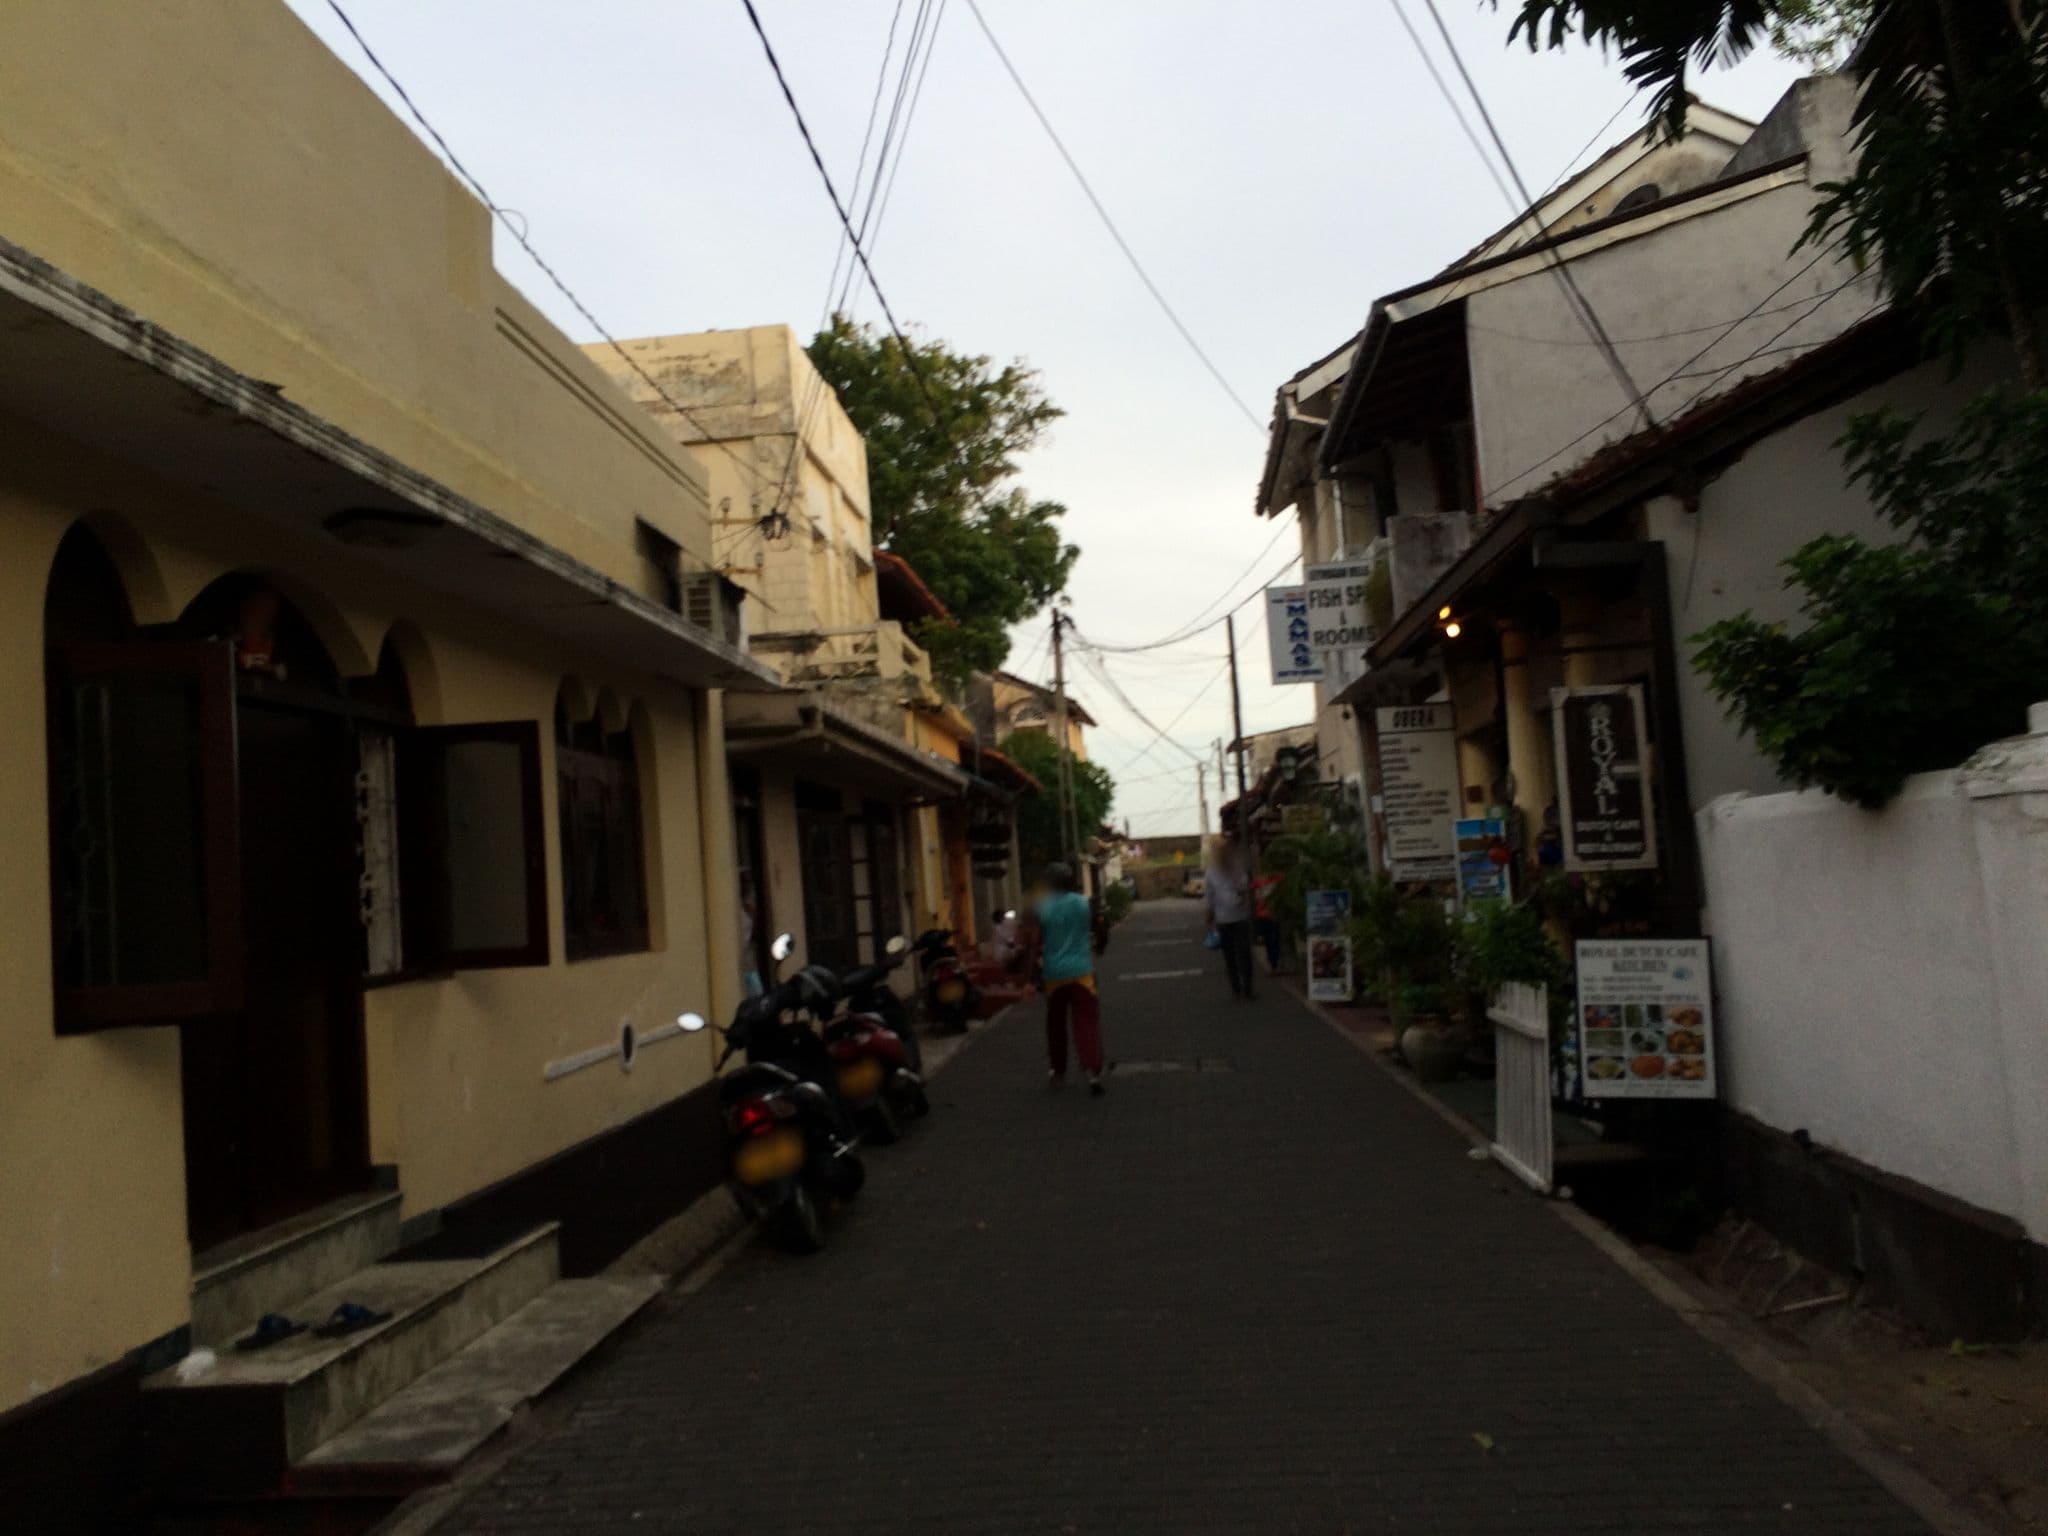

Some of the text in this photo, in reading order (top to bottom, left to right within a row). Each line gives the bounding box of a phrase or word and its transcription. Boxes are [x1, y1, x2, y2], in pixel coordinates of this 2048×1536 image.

[1309, 588, 1341, 609] FISH
[1313, 626, 1376, 646] ROOMS
[1590, 717, 1619, 815] ROYAL
[1614, 819, 1641, 831] CAFE
